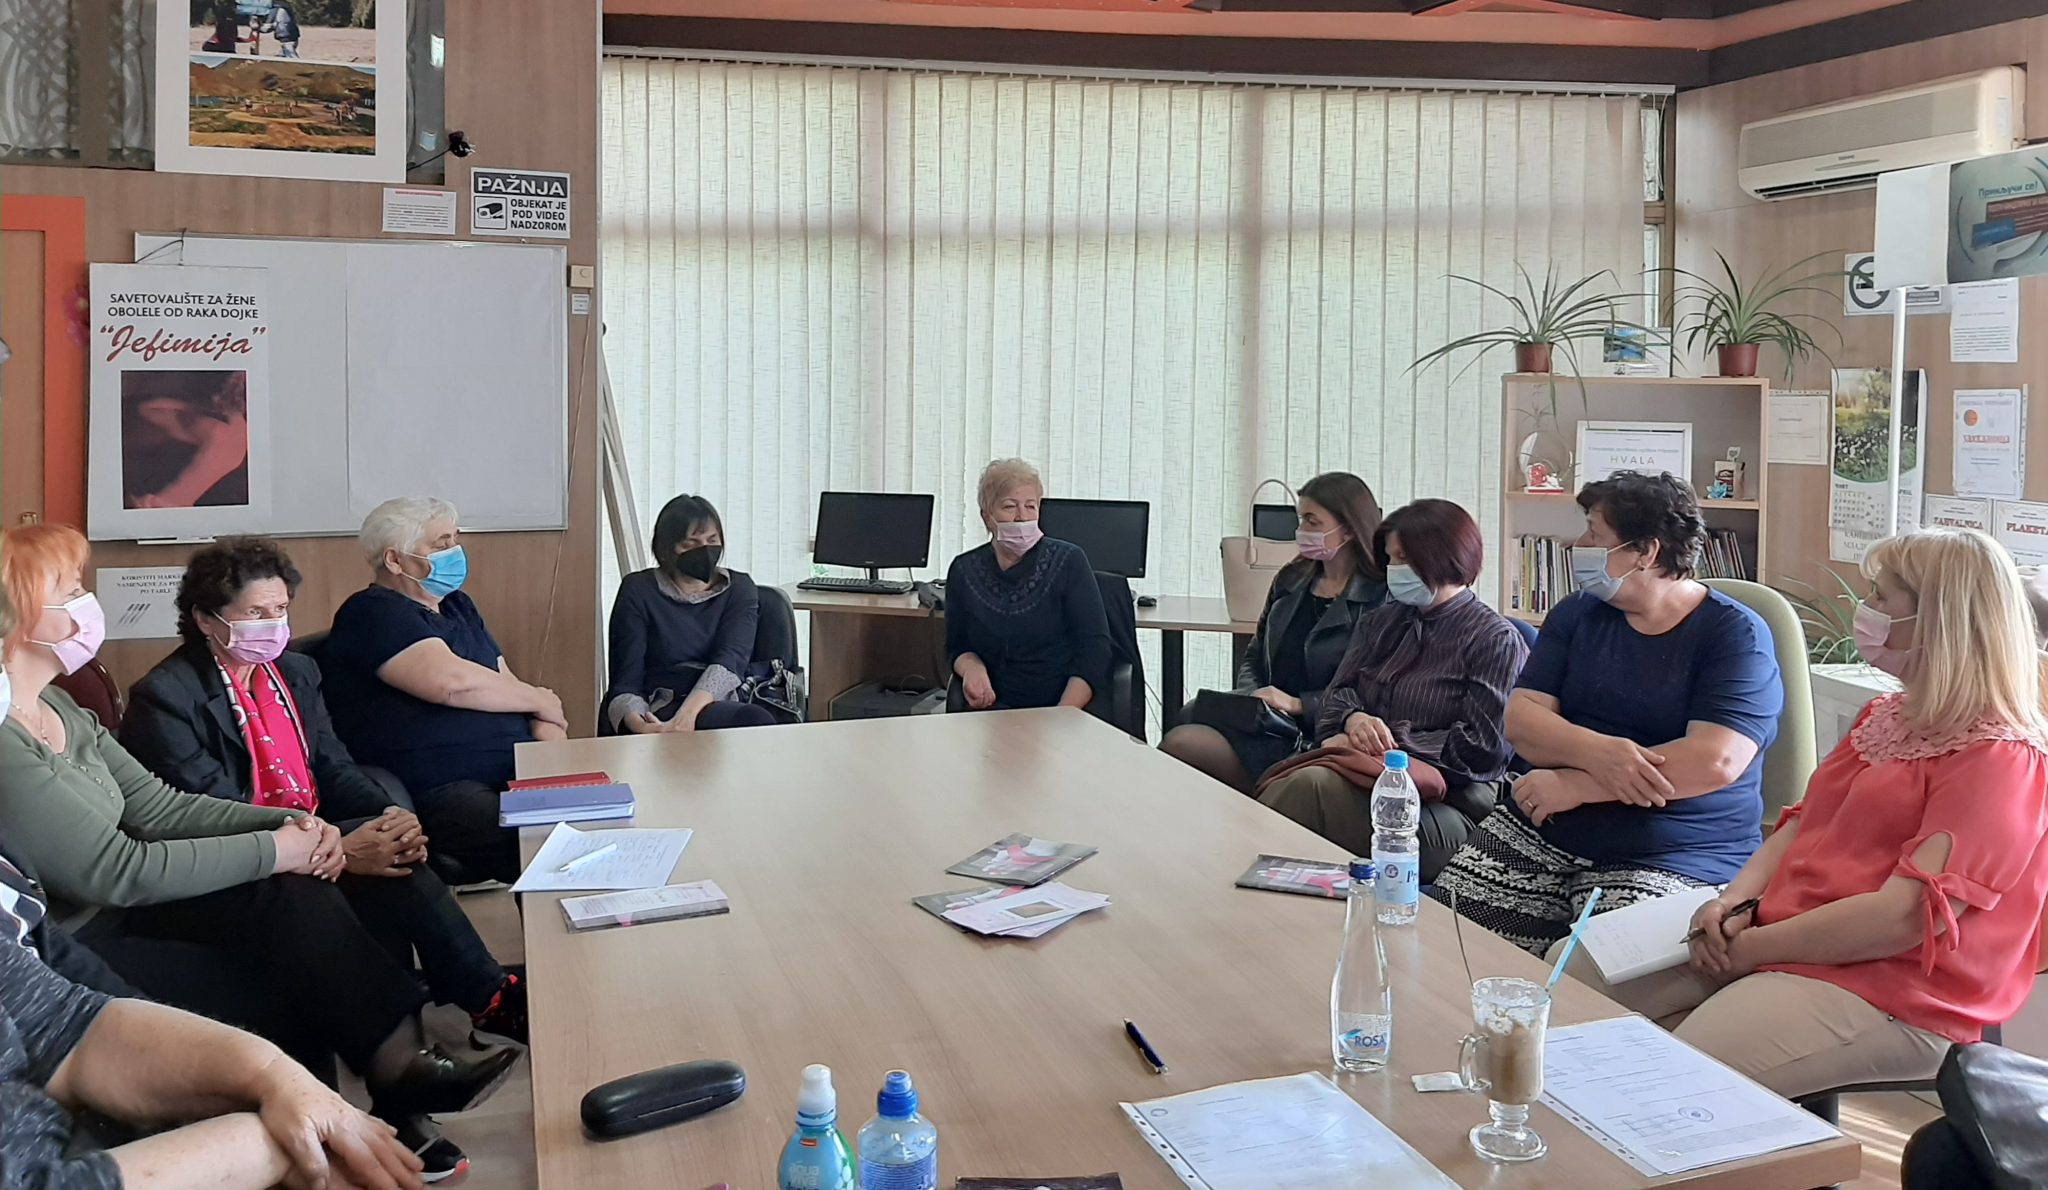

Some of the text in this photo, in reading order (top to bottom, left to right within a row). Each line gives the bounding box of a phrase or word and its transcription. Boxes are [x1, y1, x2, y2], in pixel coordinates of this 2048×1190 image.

[477, 175, 565, 196] PAŽNJA
[2025, 180, 2038, 191] се!
[511, 199, 567, 210] OBJEKAT JE
[512, 209, 565, 220] POD VIDEO
[511, 220, 567, 231] NADZOROM
[110, 292, 256, 306] SAVETOVALIŠTE ZA ŽENE
[108, 307, 259, 320] OBOLELE OD RAKA DOJKE
[1610, 455, 1655, 465] HVALA
[1355, 1035, 1387, 1047] ROSA
